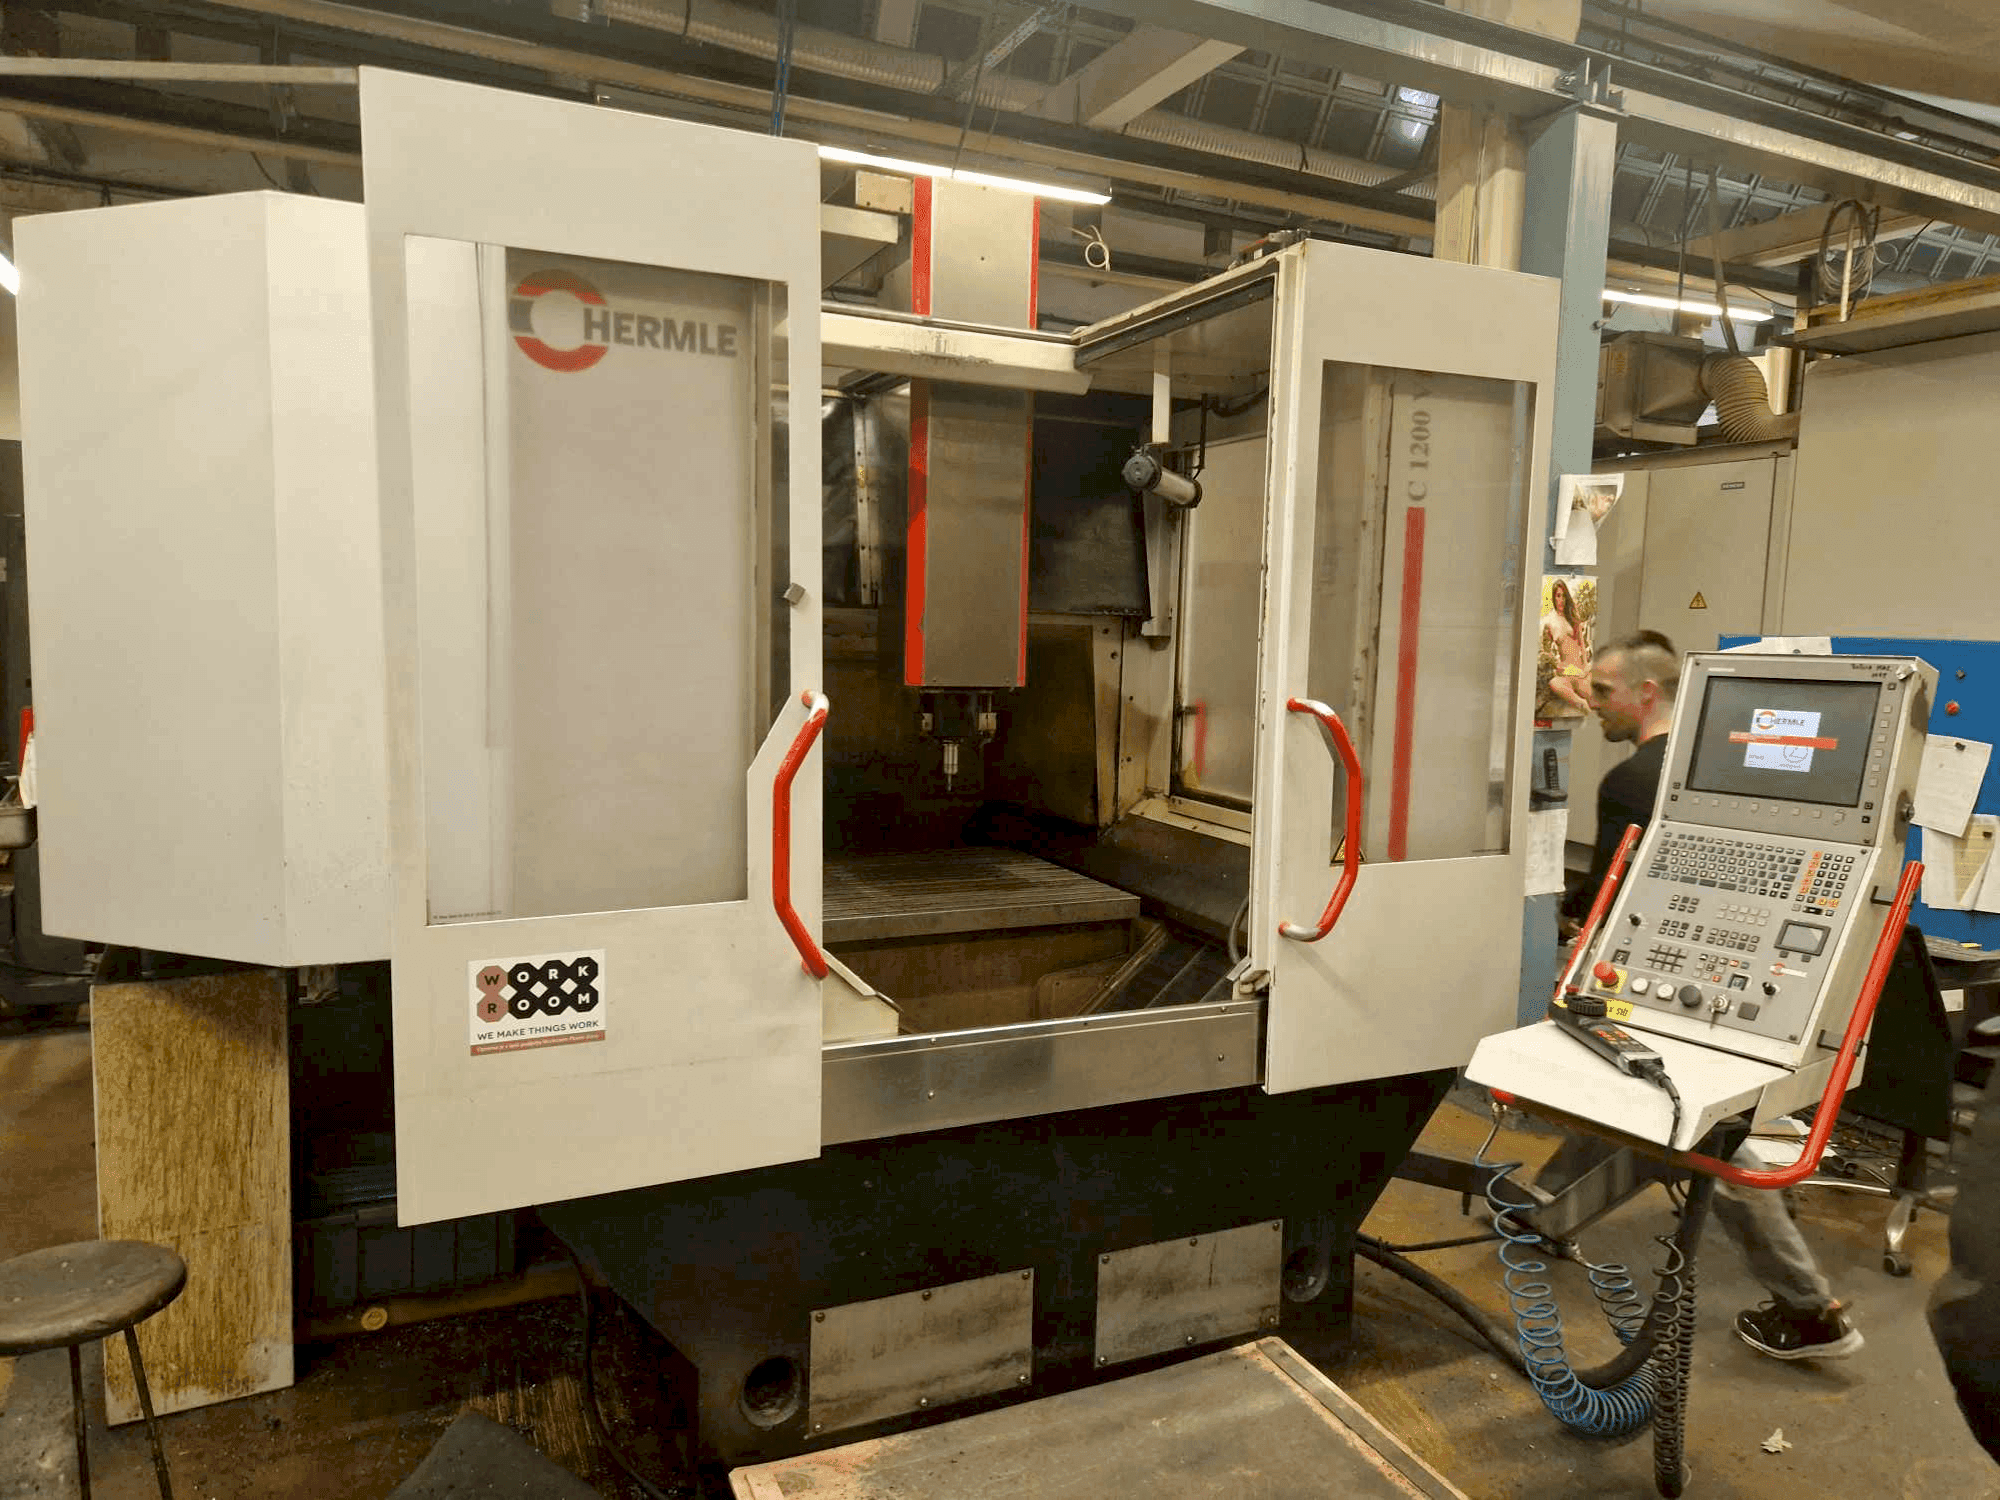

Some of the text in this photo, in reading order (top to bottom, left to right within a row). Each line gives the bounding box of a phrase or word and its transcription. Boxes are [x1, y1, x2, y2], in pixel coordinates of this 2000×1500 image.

[583, 307, 738, 358] HERMLE
[1409, 410, 1431, 470] 1200
[1408, 481, 1427, 501] C
[484, 965, 589, 986] WORK
[486, 992, 591, 1015] ROOM
[477, 1020, 599, 1041] WE MAKE THINGS WORK
